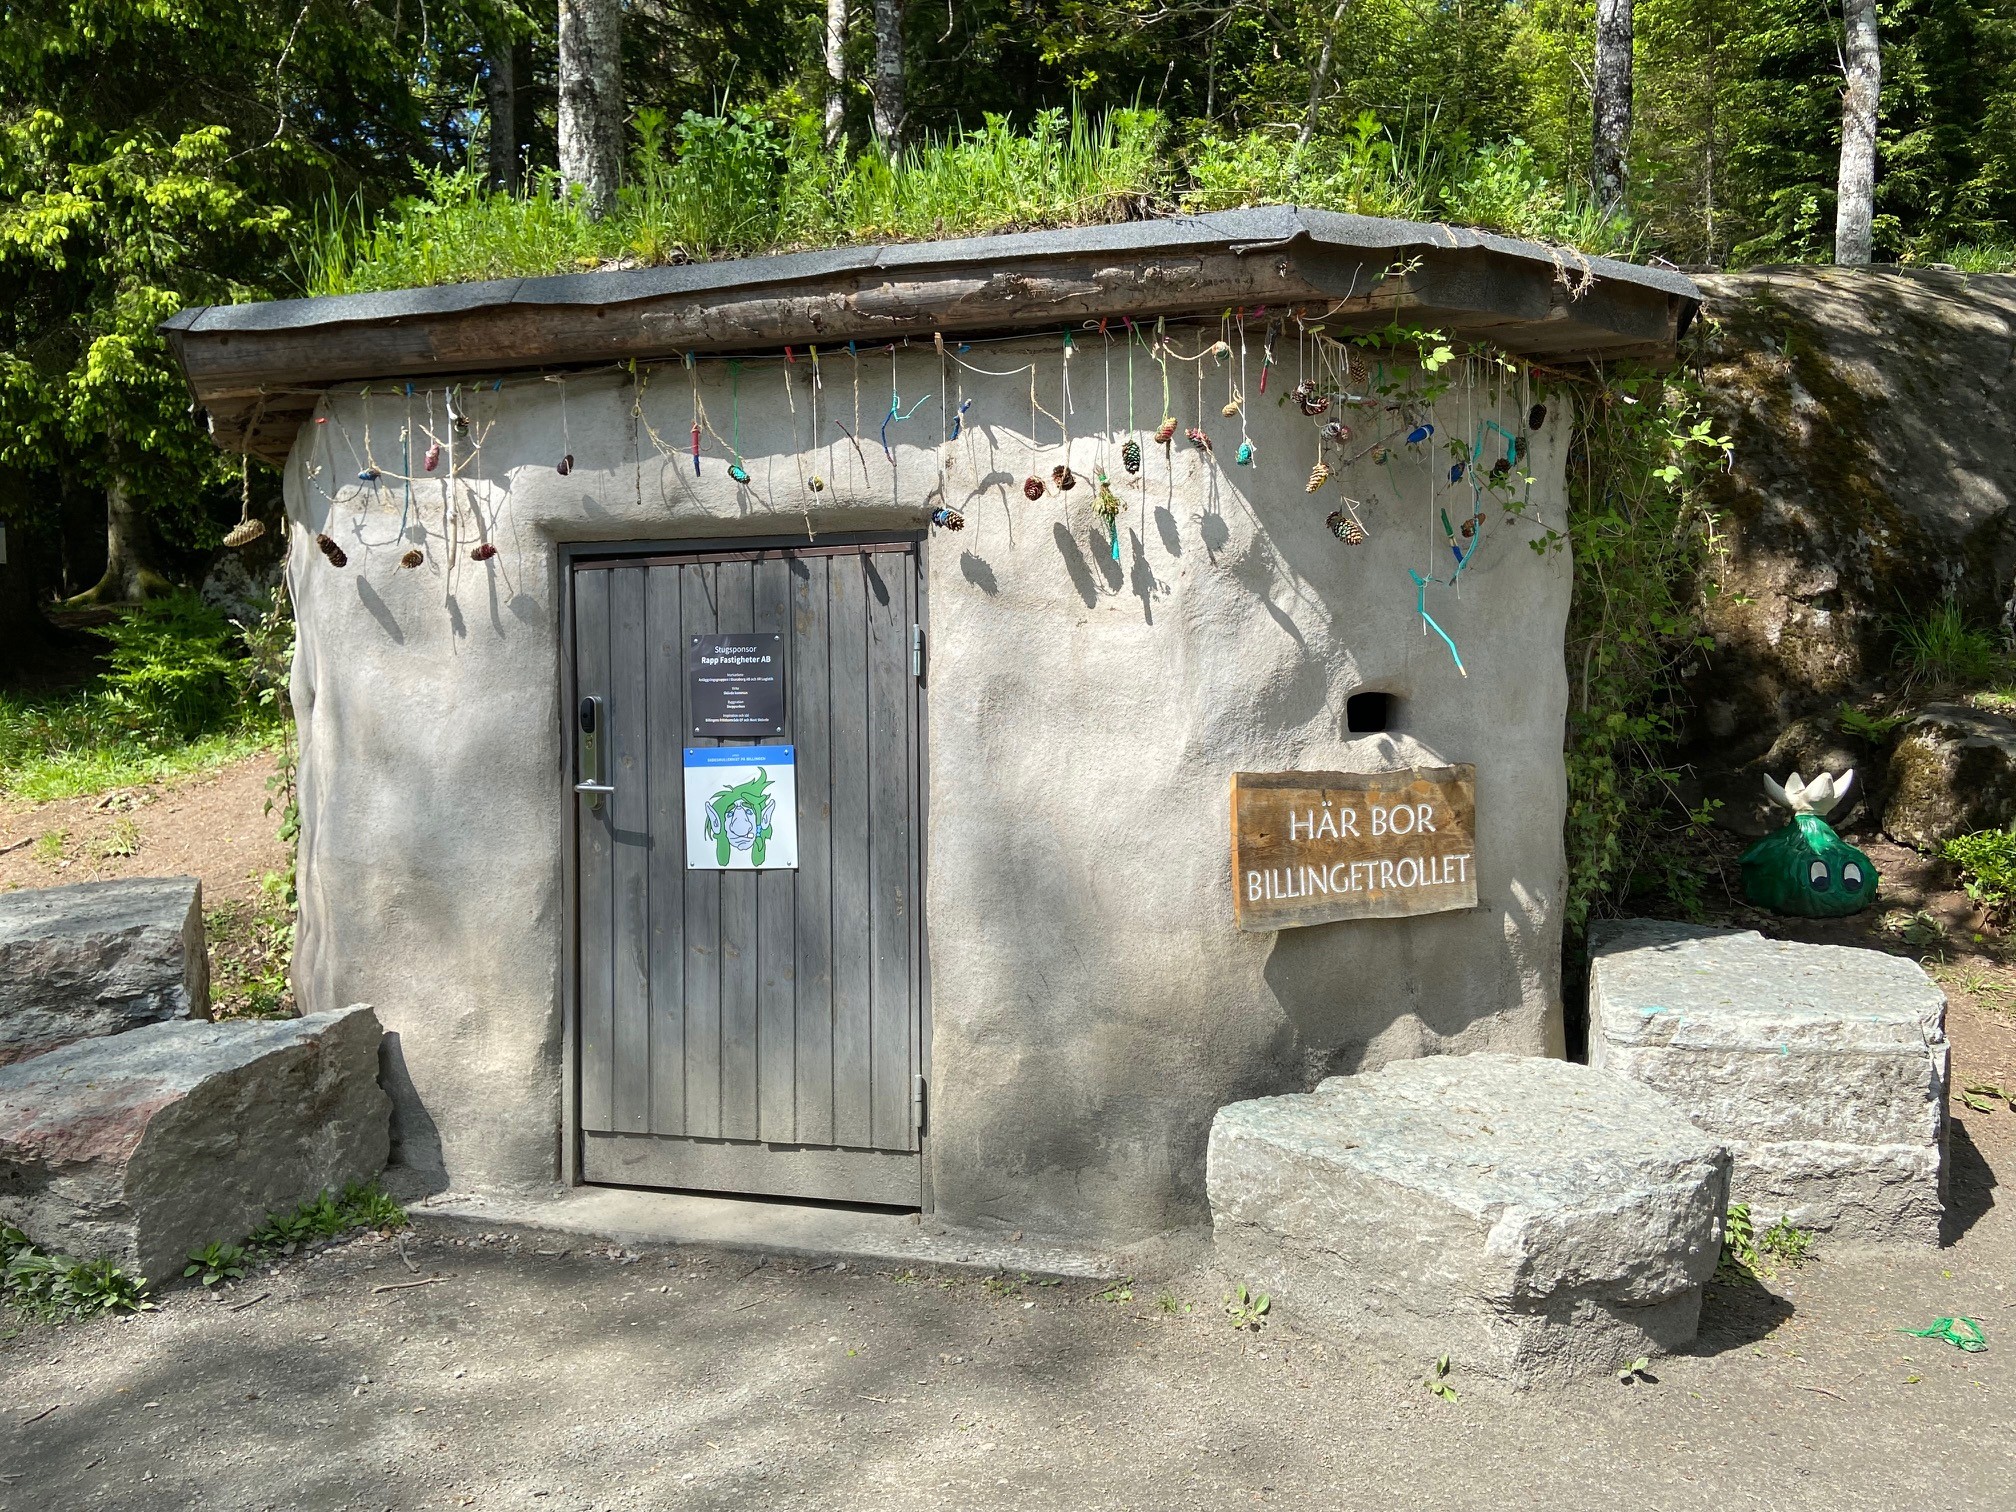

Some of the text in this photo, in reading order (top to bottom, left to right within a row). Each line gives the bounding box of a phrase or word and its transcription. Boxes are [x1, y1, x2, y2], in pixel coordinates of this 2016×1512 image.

[701, 655, 771, 665] Rapp Fastigheter AB
[714, 646, 757, 655] Stugsponsor
[1289, 800, 1437, 841] HÄR BOR
[1246, 853, 1471, 902] BILLINGETROLLET
